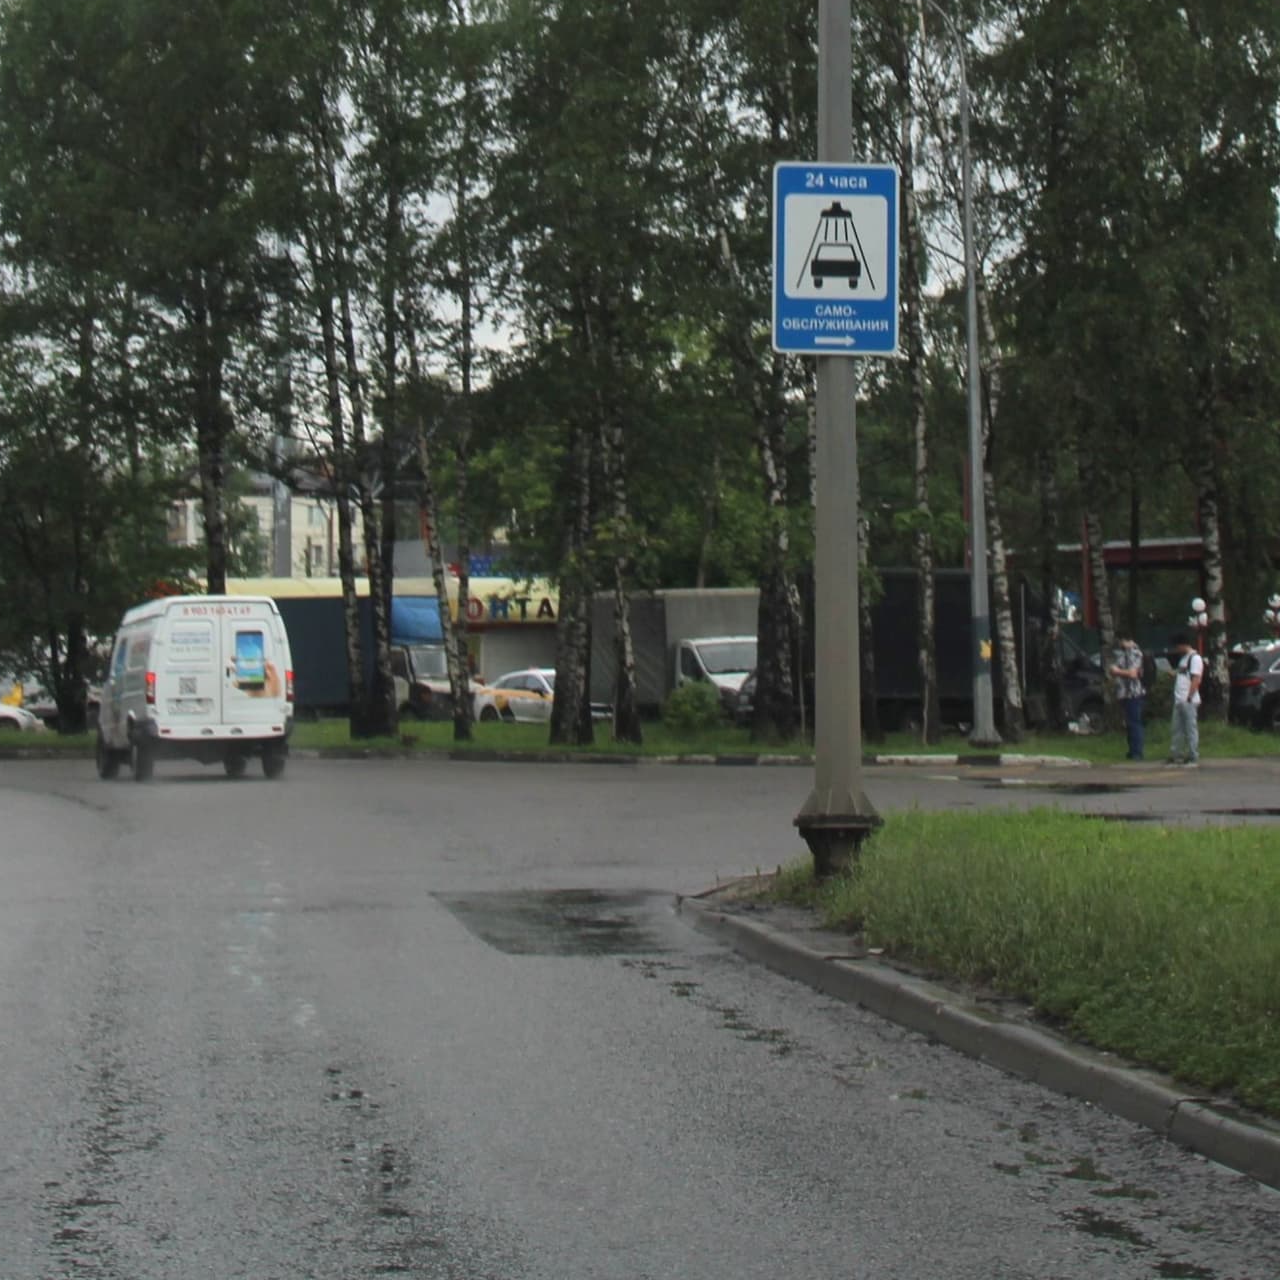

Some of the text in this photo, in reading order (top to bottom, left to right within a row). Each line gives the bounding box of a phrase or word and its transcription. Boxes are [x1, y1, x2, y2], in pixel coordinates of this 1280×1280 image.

[805, 173, 868, 189] 24 часа
[815, 304, 857, 317] САМО-
[782, 319, 889, 332] ОБСЛУЖИВАНИЯ
[451, 596, 556, 620] ОНТА
